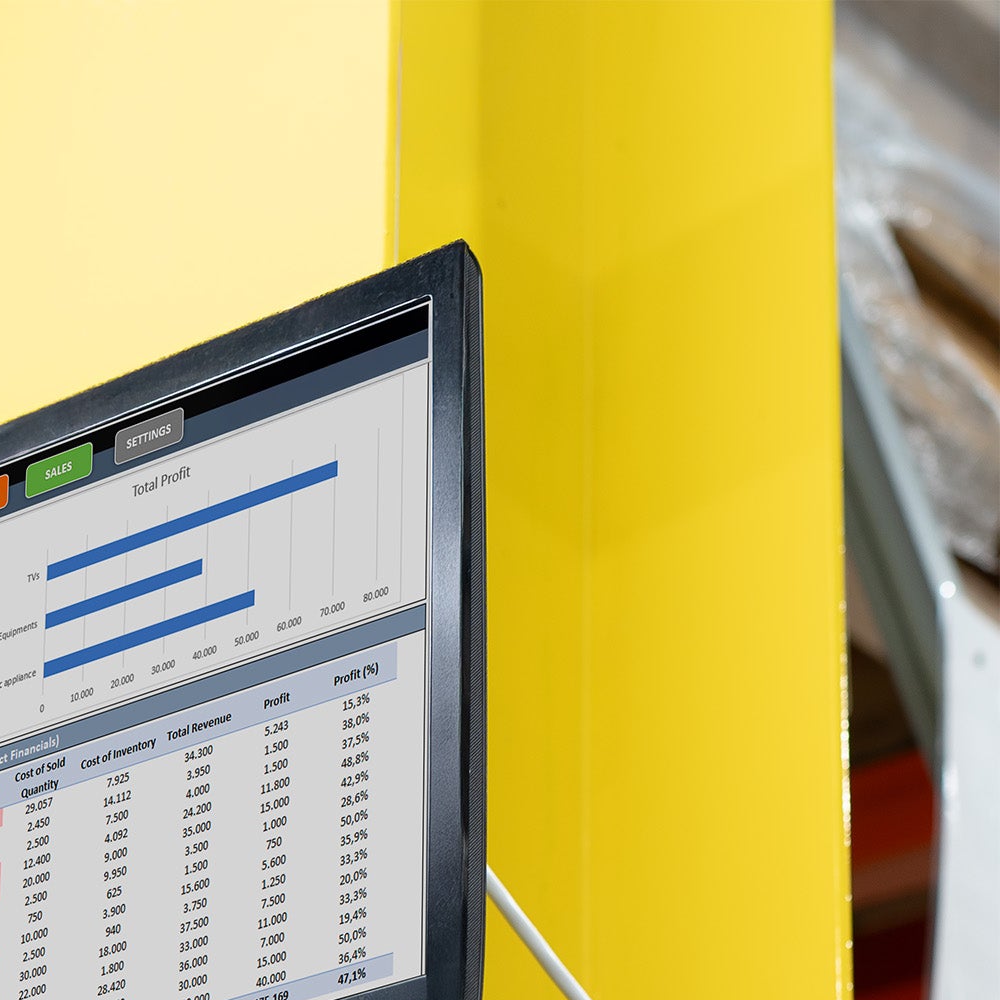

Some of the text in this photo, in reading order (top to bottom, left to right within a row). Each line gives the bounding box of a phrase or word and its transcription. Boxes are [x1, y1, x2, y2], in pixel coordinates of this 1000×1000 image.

[125, 423, 171, 449] SETTINGS
[44, 460, 72, 480] SALES
[131, 465, 191, 497] Total Profit
[26, 571, 40, 582] TVs
[362, 585, 389, 603] 80.000
[319, 600, 345, 617] 70.000
[275, 615, 302, 632] 60.000
[233, 629, 259, 647] 50.000
[191, 644, 217, 660] 40.000
[150, 658, 176, 675] 30.000
[333, 661, 379, 686] Profit (%)
[3, 669, 37, 687] appliance
[109, 672, 135, 689] 20.000
[69, 686, 94, 703] 10.000
[263, 691, 290, 709] Profit
[342, 692, 370, 711] 15,3%
[38, 703, 45, 713] 0
[166, 712, 232, 741] Total Revenue
[263, 719, 289, 737] 5.243
[9, 733, 59, 760] Financials)
[80, 737, 156, 770] Cost of Inventory
[183, 744, 213, 763] 34.300
[340, 749, 369, 768] 48,8%
[14, 755, 66, 782] Cost of Sold
[20, 778, 59, 798] Quantity
[106, 771, 129, 788] 7.925
[260, 775, 290, 795] 11.800
[24, 796, 53, 815] 29.057
[182, 800, 212, 819] 24.200
[103, 827, 128, 843] 4.092
[22, 852, 51, 870] 12.400
[338, 945, 366, 965] 36,4%
[255, 969, 286, 987] 40.000
[337, 966, 366, 985] 47,1%
